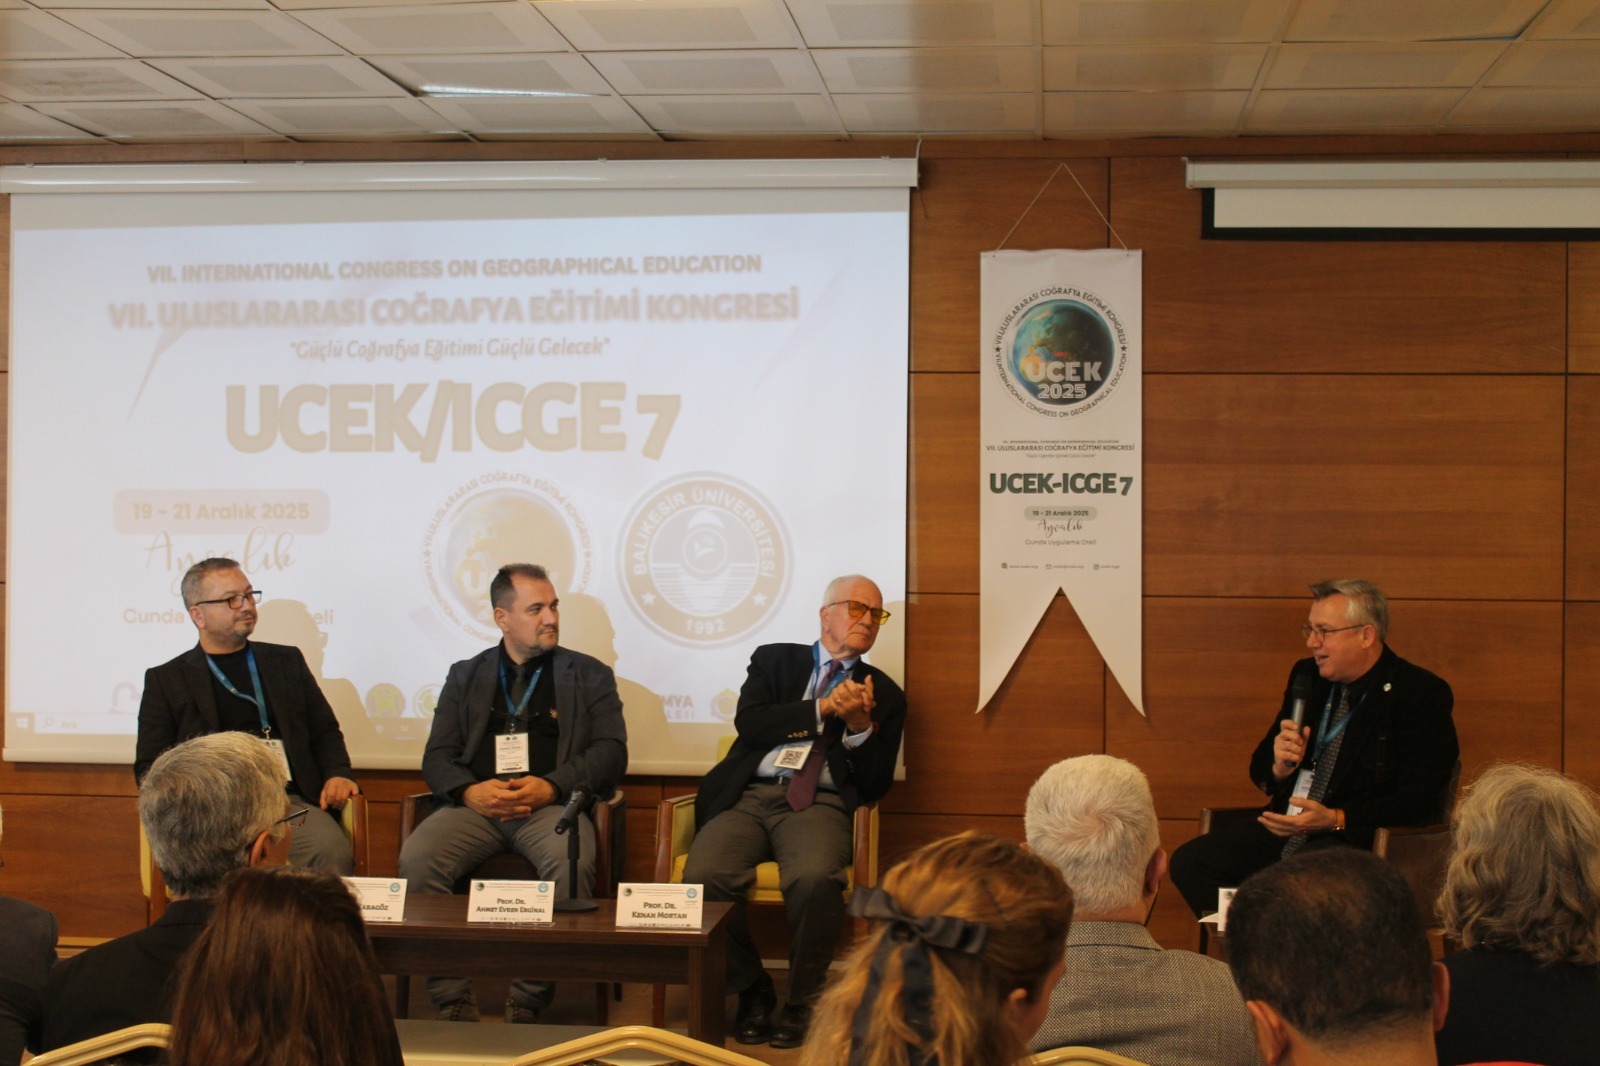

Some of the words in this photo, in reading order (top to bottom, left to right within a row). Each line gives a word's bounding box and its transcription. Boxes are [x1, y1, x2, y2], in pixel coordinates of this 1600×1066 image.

[147, 265, 178, 283] VII.
[182, 262, 334, 282] INTERNATIONAL
[338, 259, 443, 280] CONGRESS
[448, 259, 478, 278] ON
[482, 256, 638, 277] GEOGRAPHICAL
[643, 254, 762, 275] EDUCATION
[1040, 286, 1081, 300] COĞRAFYA
[109, 303, 153, 329] VII.
[158, 298, 366, 329] ULUSLARARASI
[370, 291, 524, 325] COĞRAFYA
[529, 288, 640, 324] EĞİTİMİ
[647, 286, 800, 322] KONGRESİ
[346, 338, 420, 361] Coğrafya
[423, 338, 483, 360] Eğitimi
[486, 338, 535, 360] Güçlü
[1025, 361, 1102, 382] UCEK
[1026, 402, 1057, 418] CONGRESS
[1070, 387, 1113, 417] GEOGRAPHICAL
[1112, 352, 1127, 387] EDUCATION
[1037, 383, 1087, 399] 2025
[226, 379, 627, 463] UCEK/ICGE
[636, 394, 682, 461] 7
[989, 473, 1117, 494] UCEK-ICGE
[1119, 477, 1133, 496] 7
[132, 503, 153, 520] 19
[173, 503, 191, 520] 21
[196, 502, 256, 520] Aralık
[260, 502, 310, 519] 2025
[633, 491, 687, 575] BALIKESİR
[691, 486, 776, 578] ÜNİVERSİTESİ
[122, 608, 185, 624] Cunda
[686, 618, 726, 634] 1992
